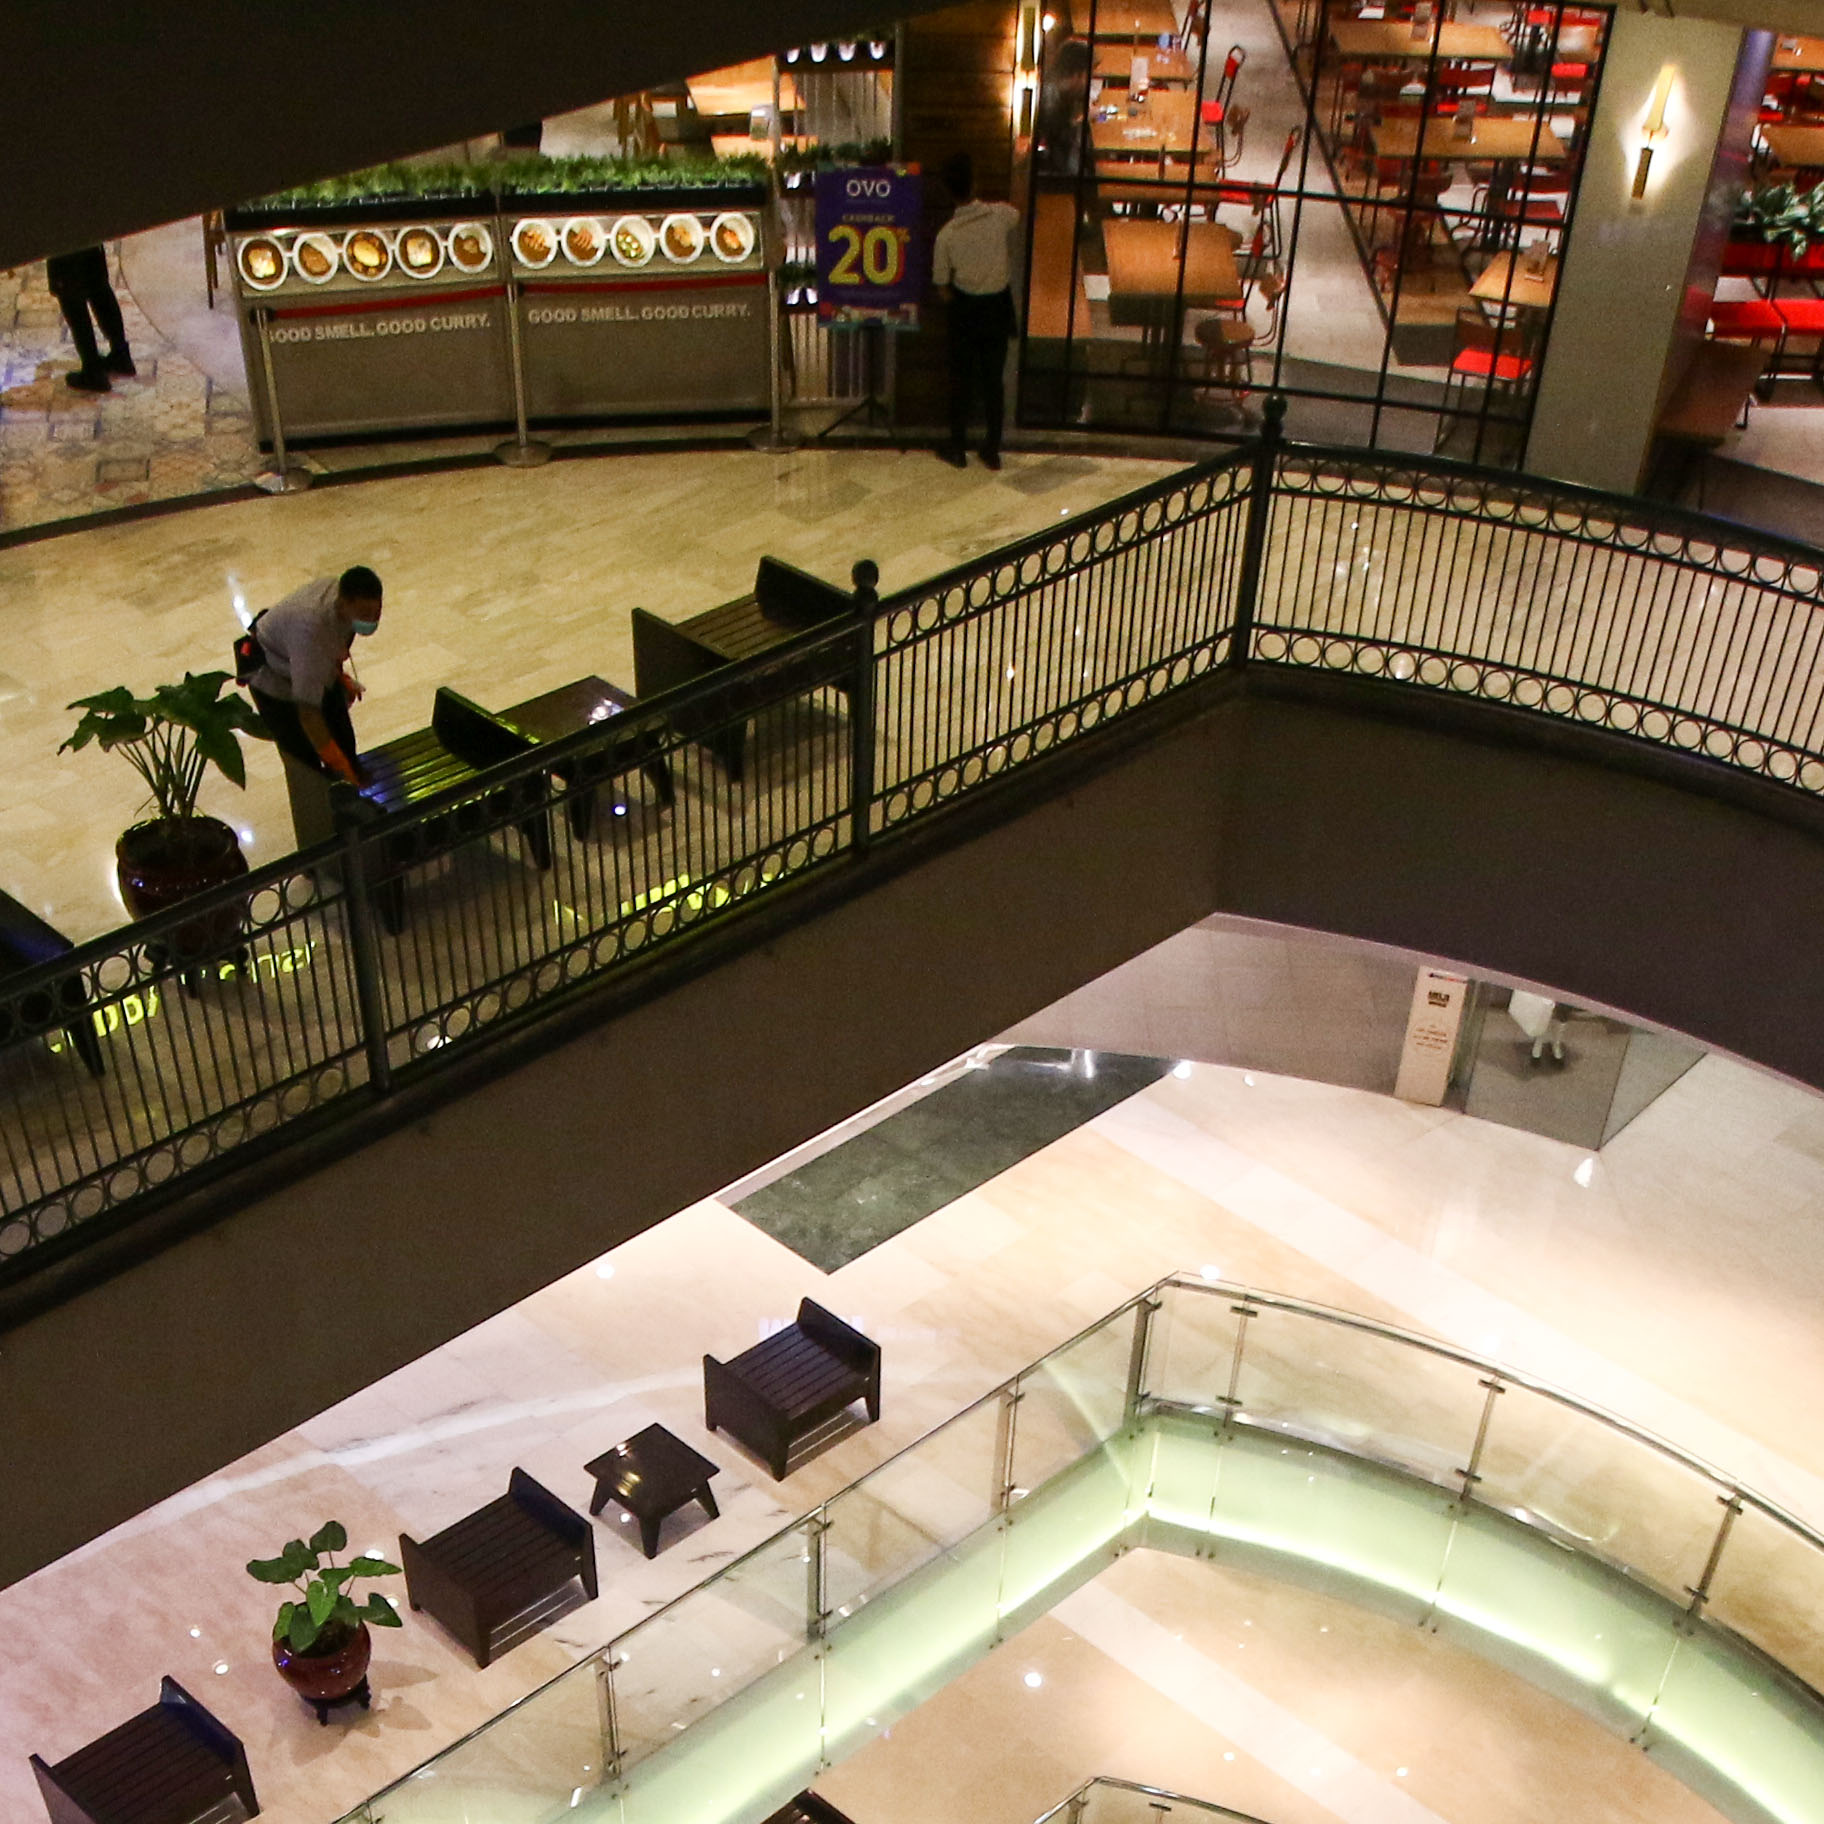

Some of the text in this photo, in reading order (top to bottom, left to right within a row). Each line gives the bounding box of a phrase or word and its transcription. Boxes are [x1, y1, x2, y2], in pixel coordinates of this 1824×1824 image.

[846, 179, 891, 197] OVO
[528, 308, 577, 324] GOOD
[641, 304, 690, 320] GOOD
[376, 318, 426, 337] GOOD
